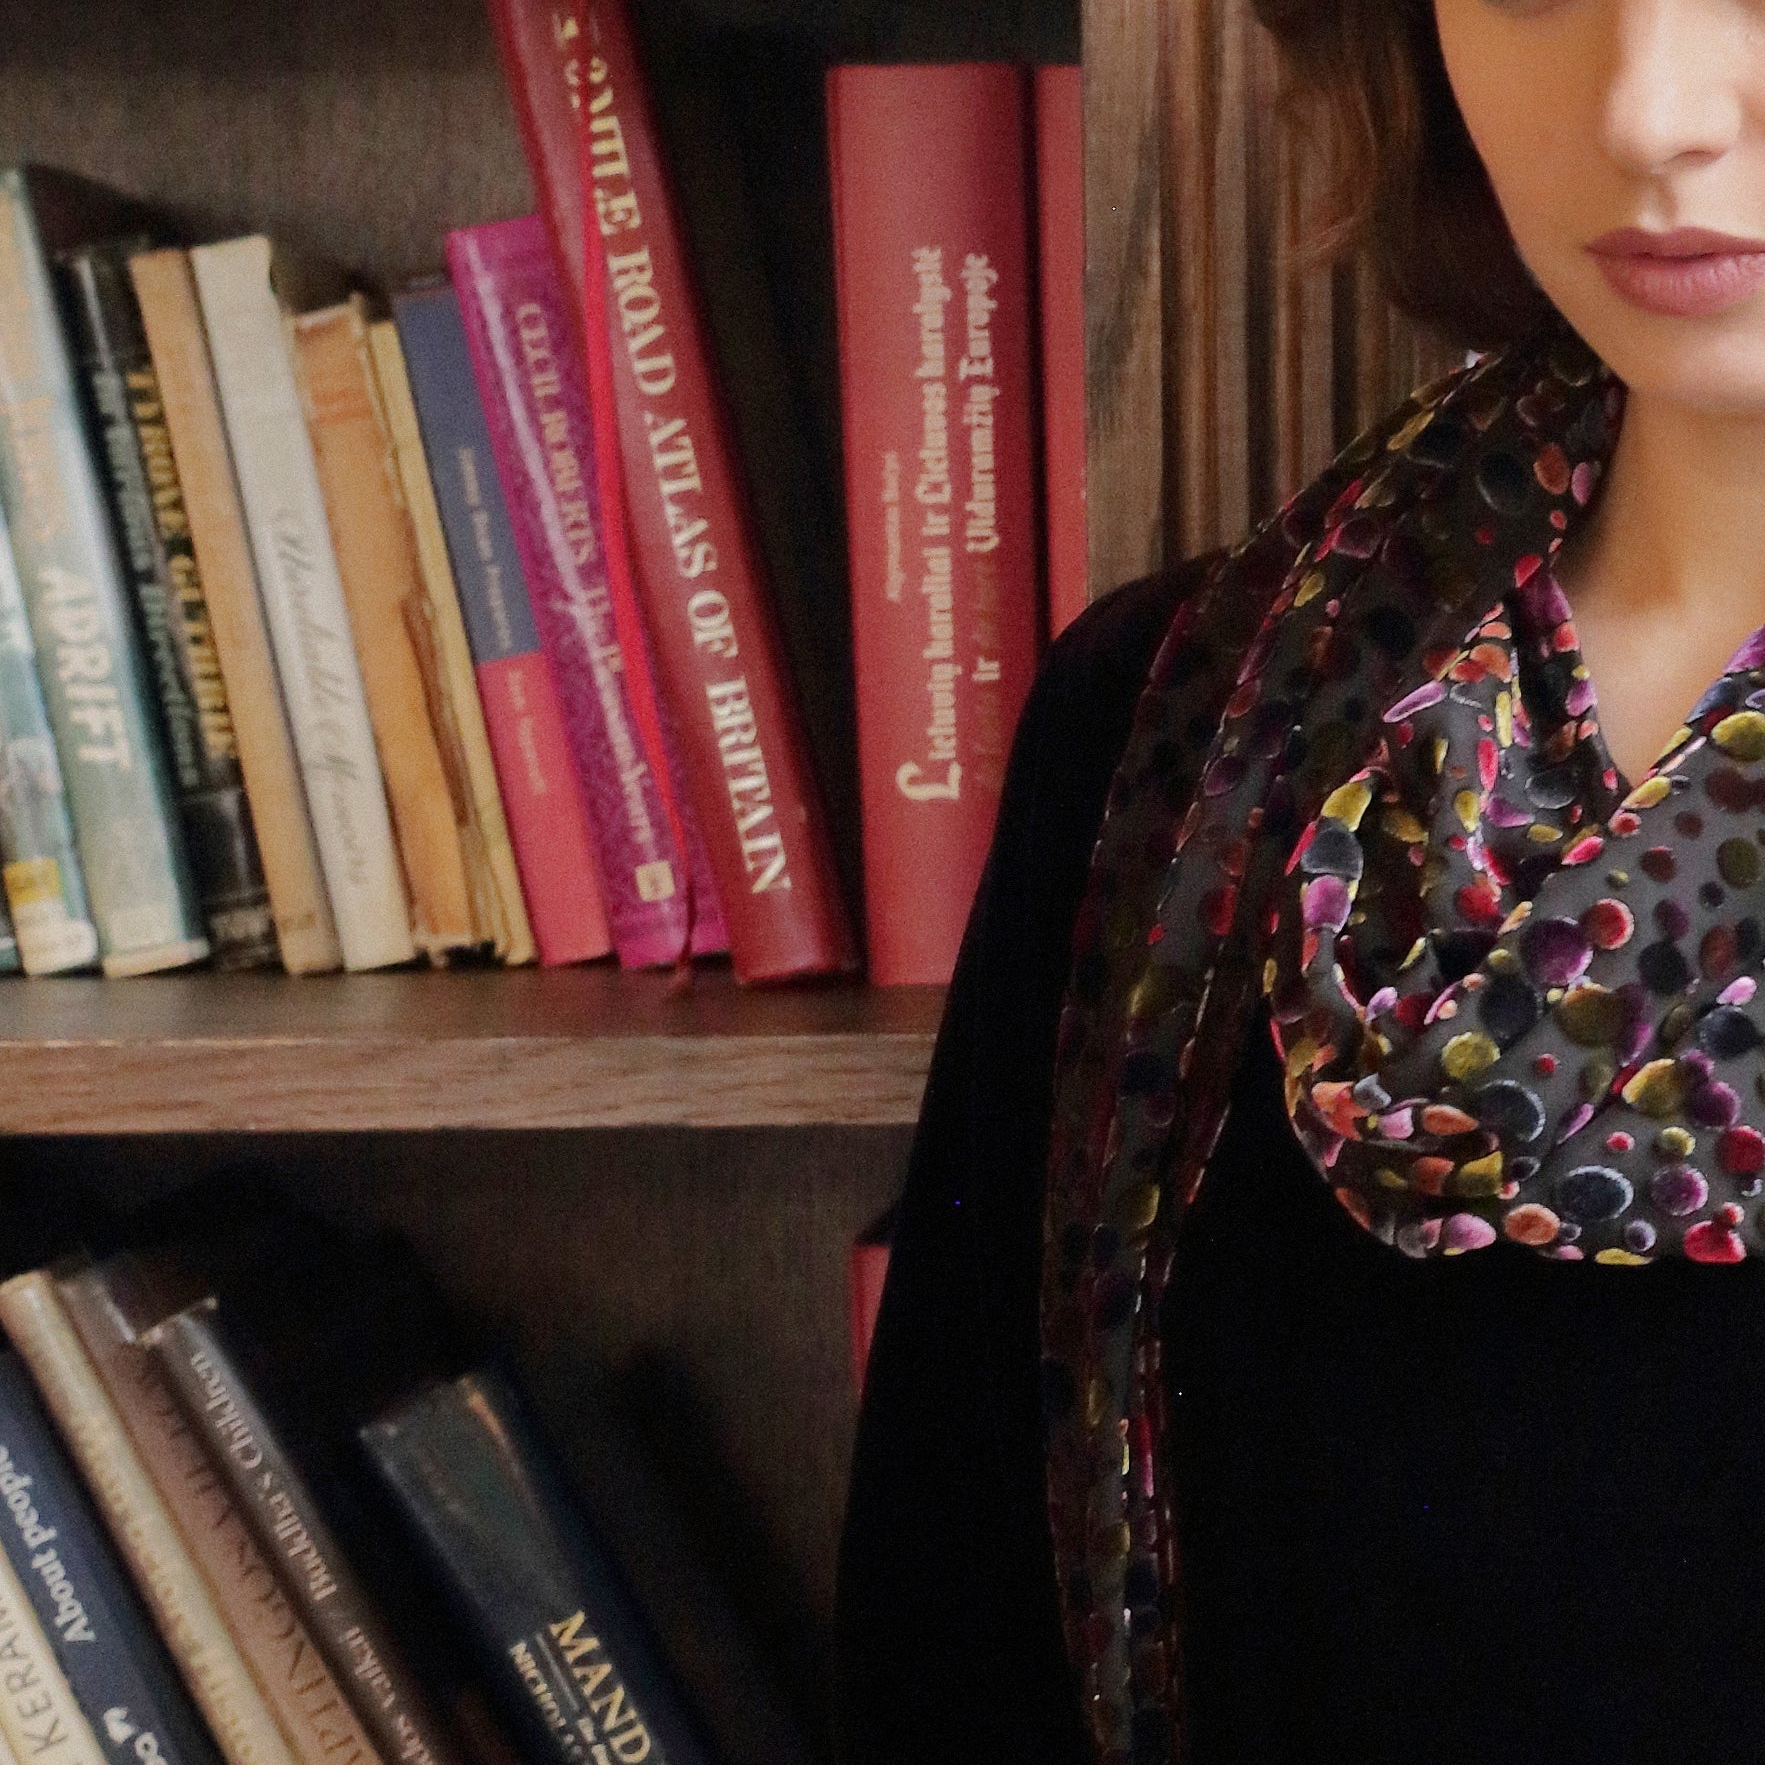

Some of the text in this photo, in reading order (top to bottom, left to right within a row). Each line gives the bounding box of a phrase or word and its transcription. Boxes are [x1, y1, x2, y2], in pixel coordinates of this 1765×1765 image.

[606, 244, 683, 398] ROAD
[514, 299, 562, 398] CECIL
[538, 406, 601, 567] ROBERTS
[640, 404, 724, 580] ATLAS
[35, 557, 137, 781] ADRIFT
[683, 585, 743, 665] OF
[704, 675, 794, 902] BRITAIN
[181, 1348, 267, 1473] Children
[54, 1549, 95, 1641] About
[249, 1468, 337, 1603] Buddha's
[335, 1623, 401, 1715] vaikai
